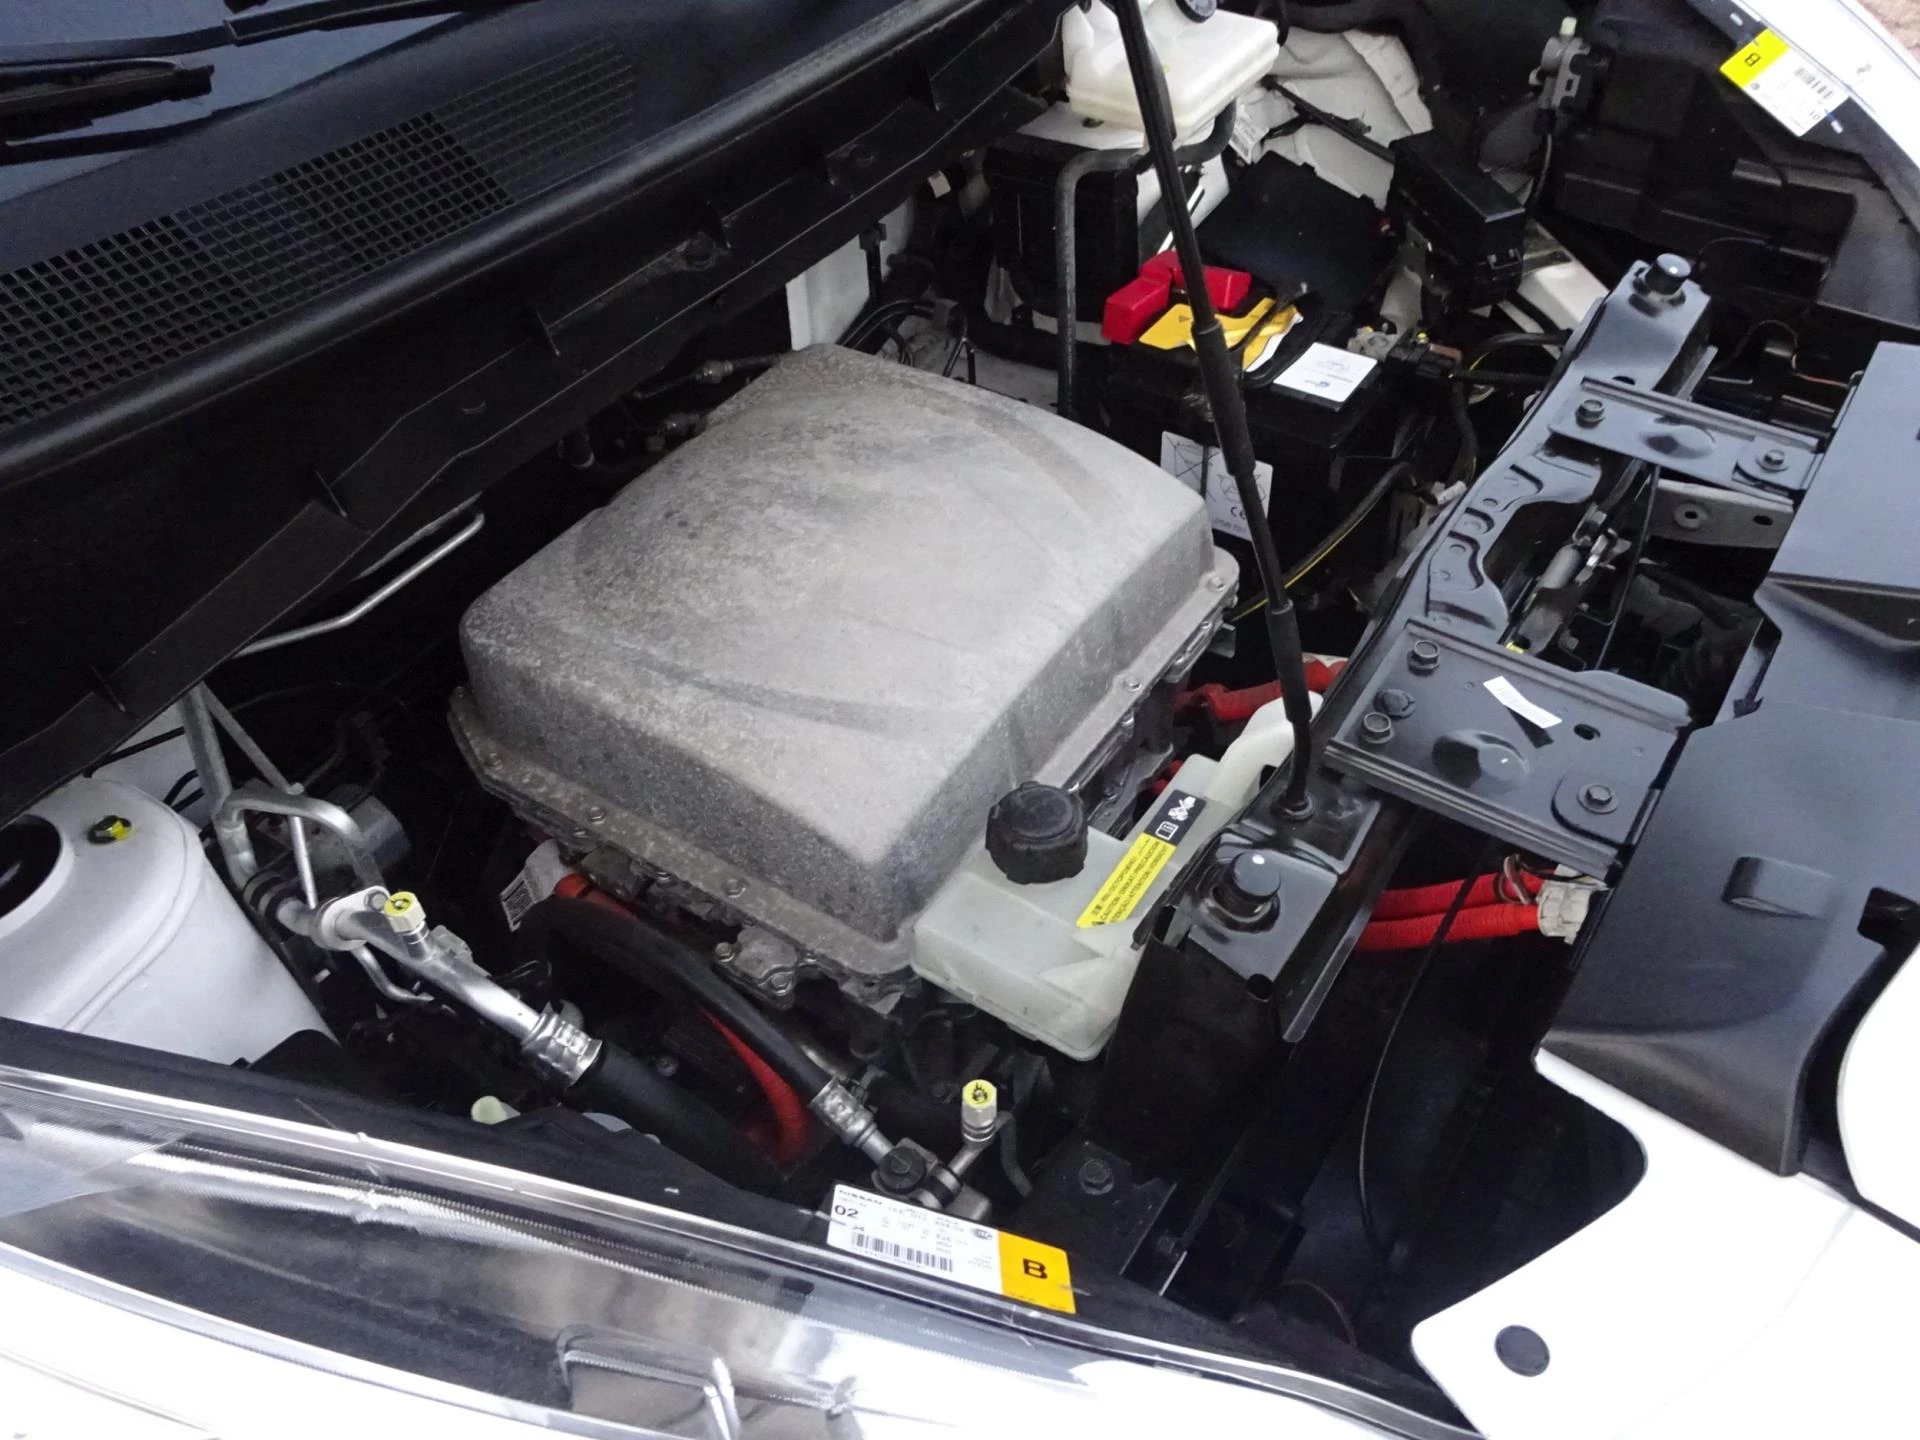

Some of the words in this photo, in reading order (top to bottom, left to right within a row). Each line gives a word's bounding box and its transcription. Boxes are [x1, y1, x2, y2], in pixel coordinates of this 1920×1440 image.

[1744, 53, 1761, 66] B
[1100, 895, 1120, 921] CAUTION
[833, 1203, 859, 1219] 02
[1023, 1259, 1047, 1279] B
